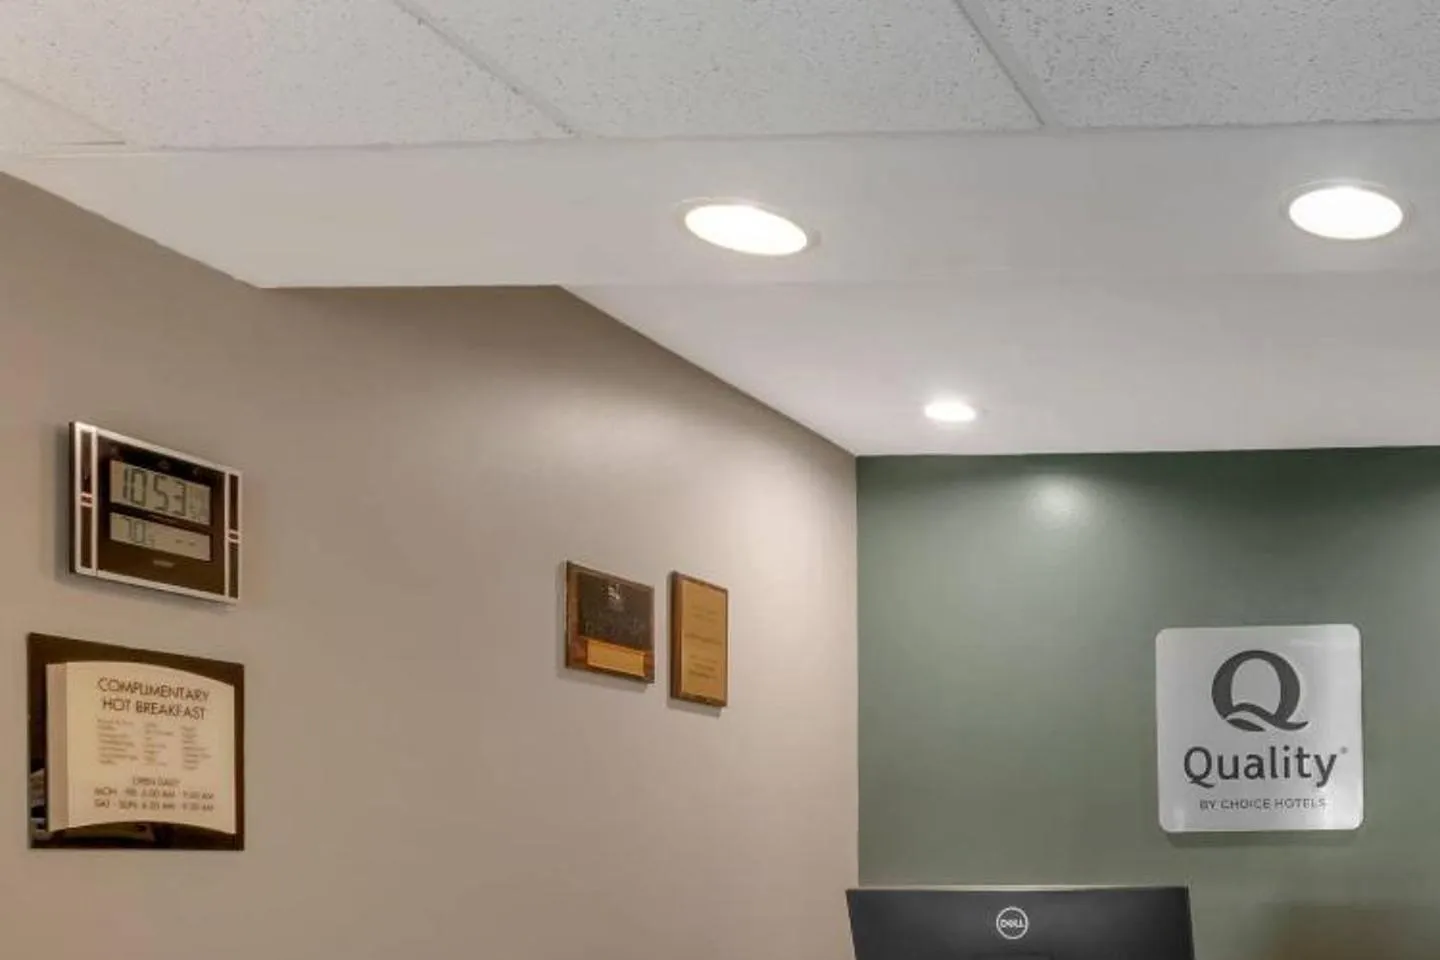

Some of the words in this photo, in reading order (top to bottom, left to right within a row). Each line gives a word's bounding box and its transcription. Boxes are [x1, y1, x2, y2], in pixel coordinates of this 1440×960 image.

[97, 677, 210, 701] COMPLIMENTARY
[103, 697, 131, 712] HOT
[135, 700, 205, 720] BREAKFAST
[1184, 745, 1337, 789] Quality
[1220, 799, 1271, 809] CHOICE
[1274, 798, 1327, 809] HOTELS
